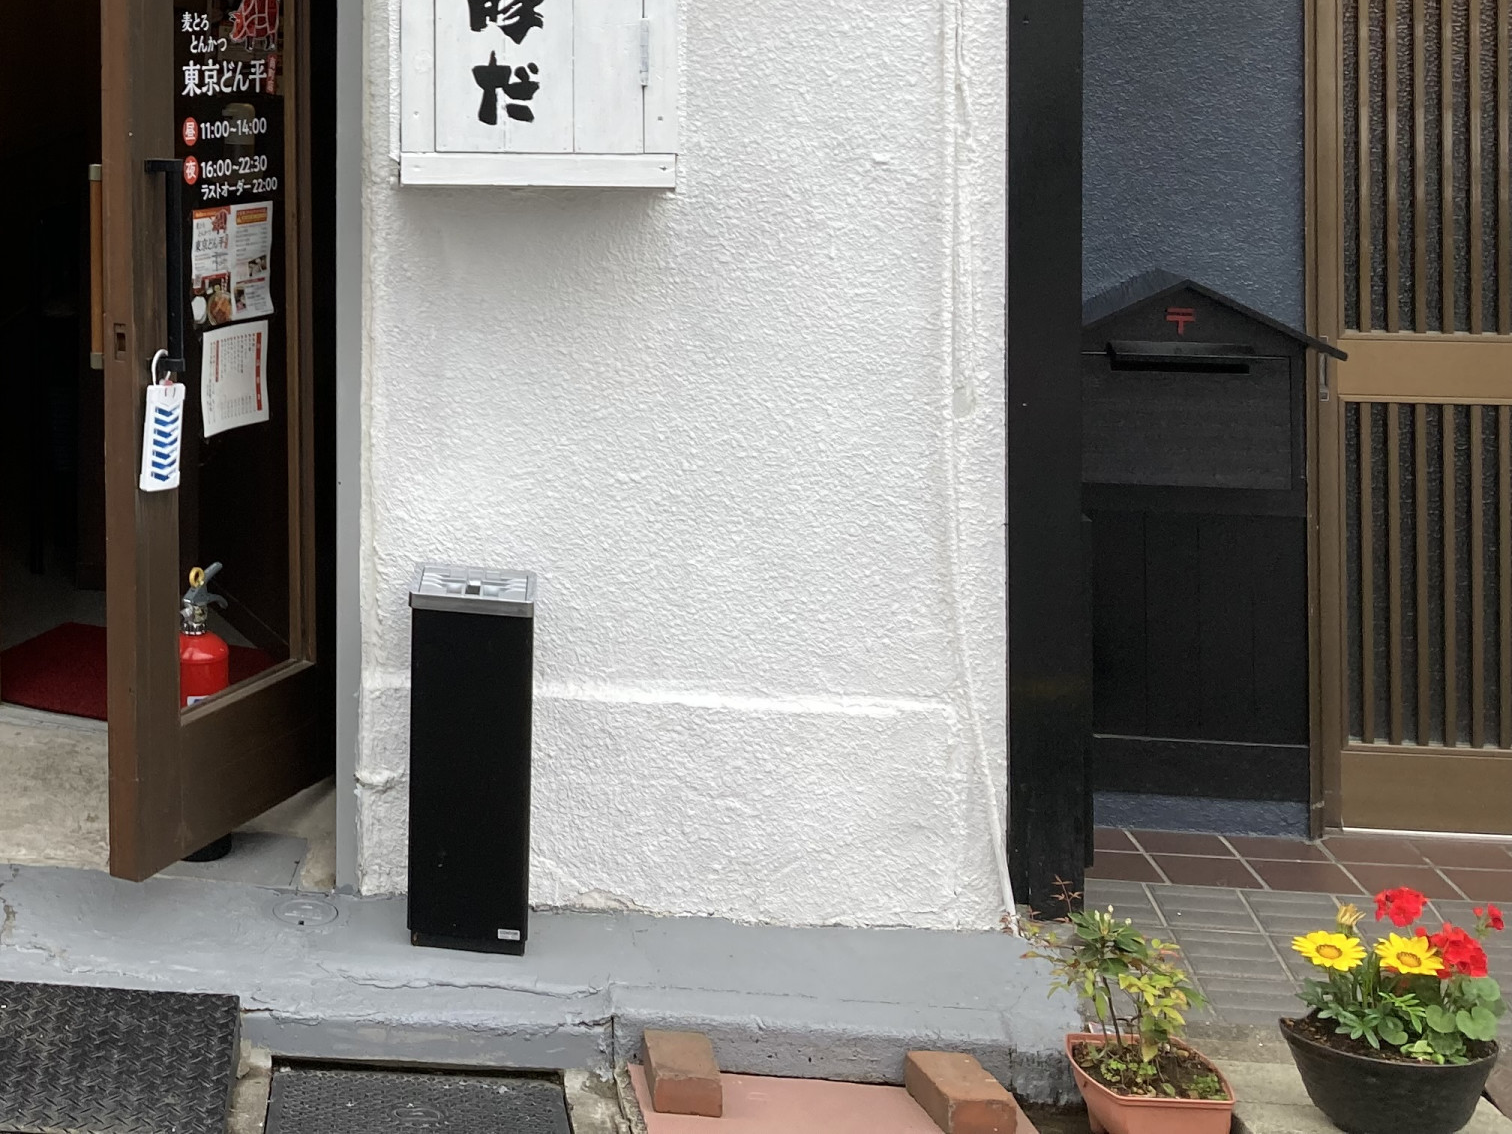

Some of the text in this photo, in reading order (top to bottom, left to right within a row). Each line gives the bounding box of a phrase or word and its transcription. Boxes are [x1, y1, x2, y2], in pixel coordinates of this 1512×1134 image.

[181, 11, 209, 32] 麦とろ
[190, 35, 227, 53] とんかつ
[181, 59, 267, 97] 東京どん平
[185, 122, 196, 141] 昼
[185, 160, 196, 179] 夜
[201, 177, 278, 200] ラストオーダー 22:00
